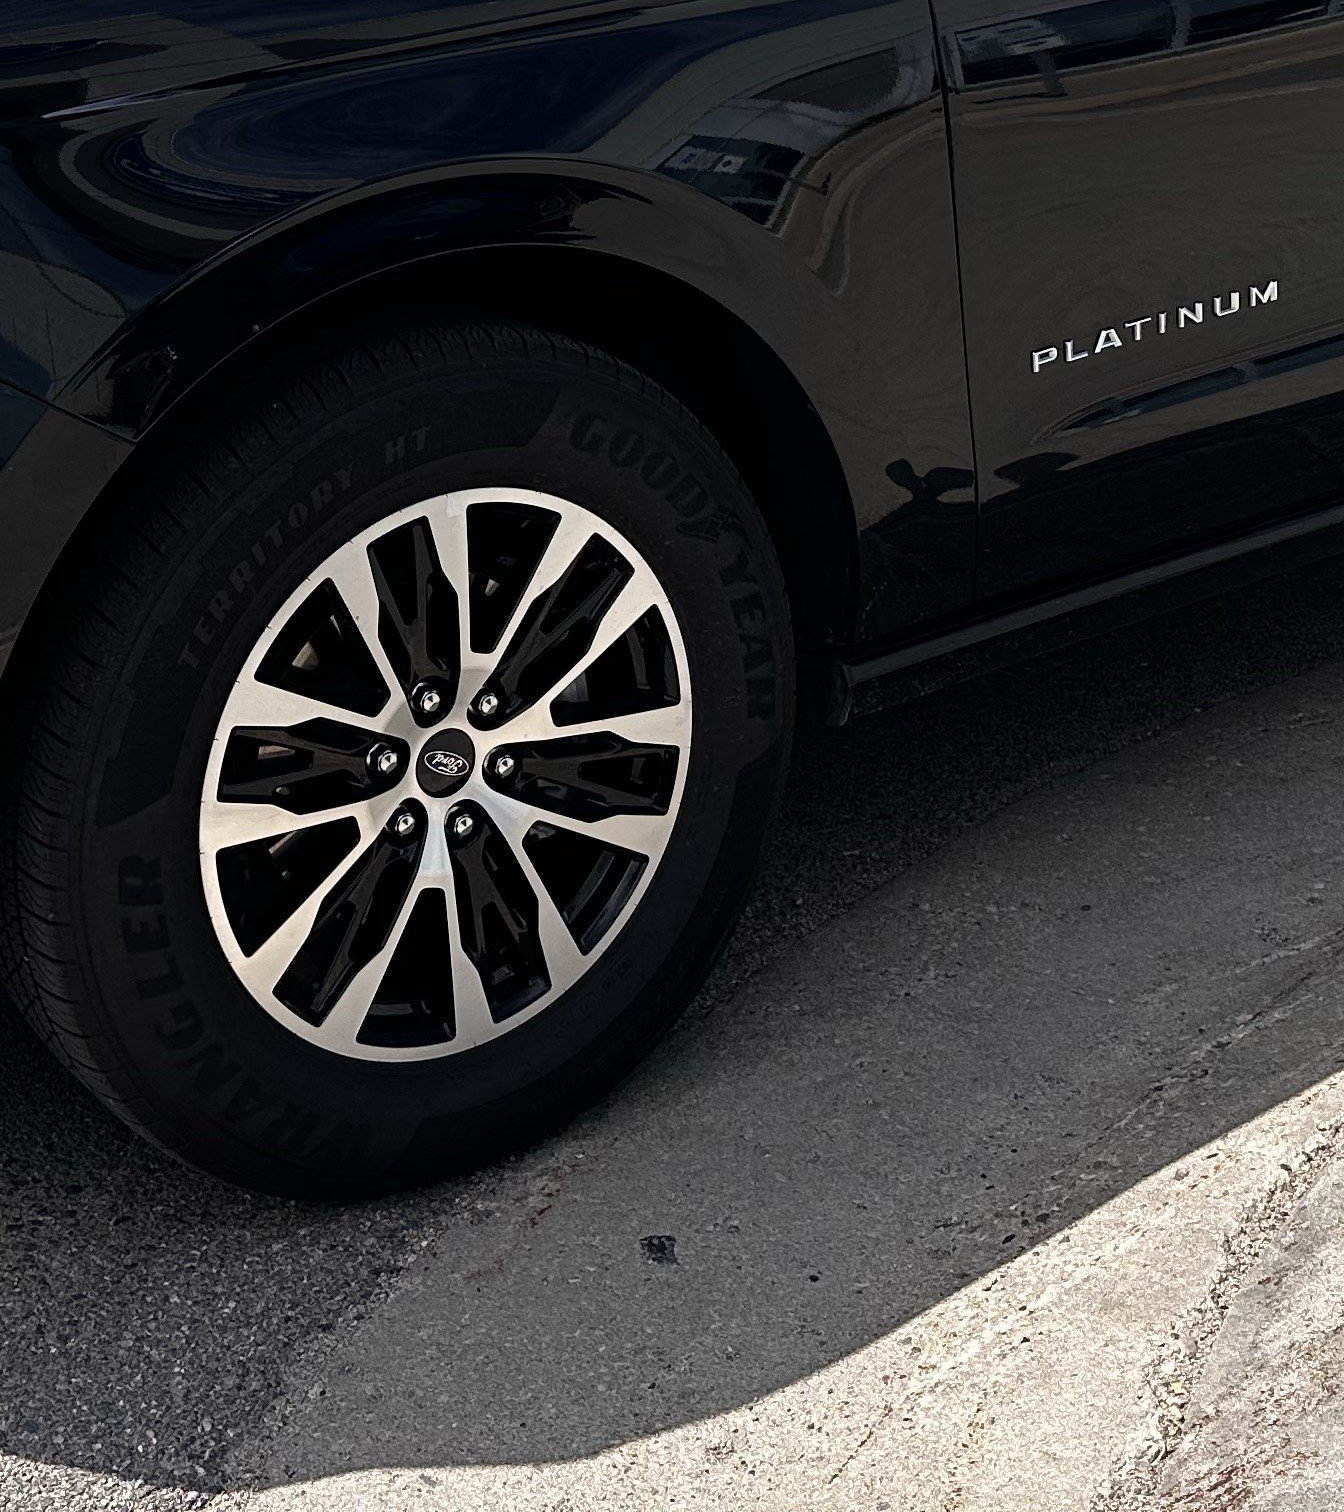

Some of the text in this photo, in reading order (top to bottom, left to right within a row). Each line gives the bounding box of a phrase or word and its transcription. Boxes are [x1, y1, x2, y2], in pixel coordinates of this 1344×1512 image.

[1031, 279, 1279, 374] PLATINUM
[177, 425, 433, 670] TERRITORY HT
[570, 410, 778, 721] GOODYEAR
[431, 753, 463, 774] Ford
